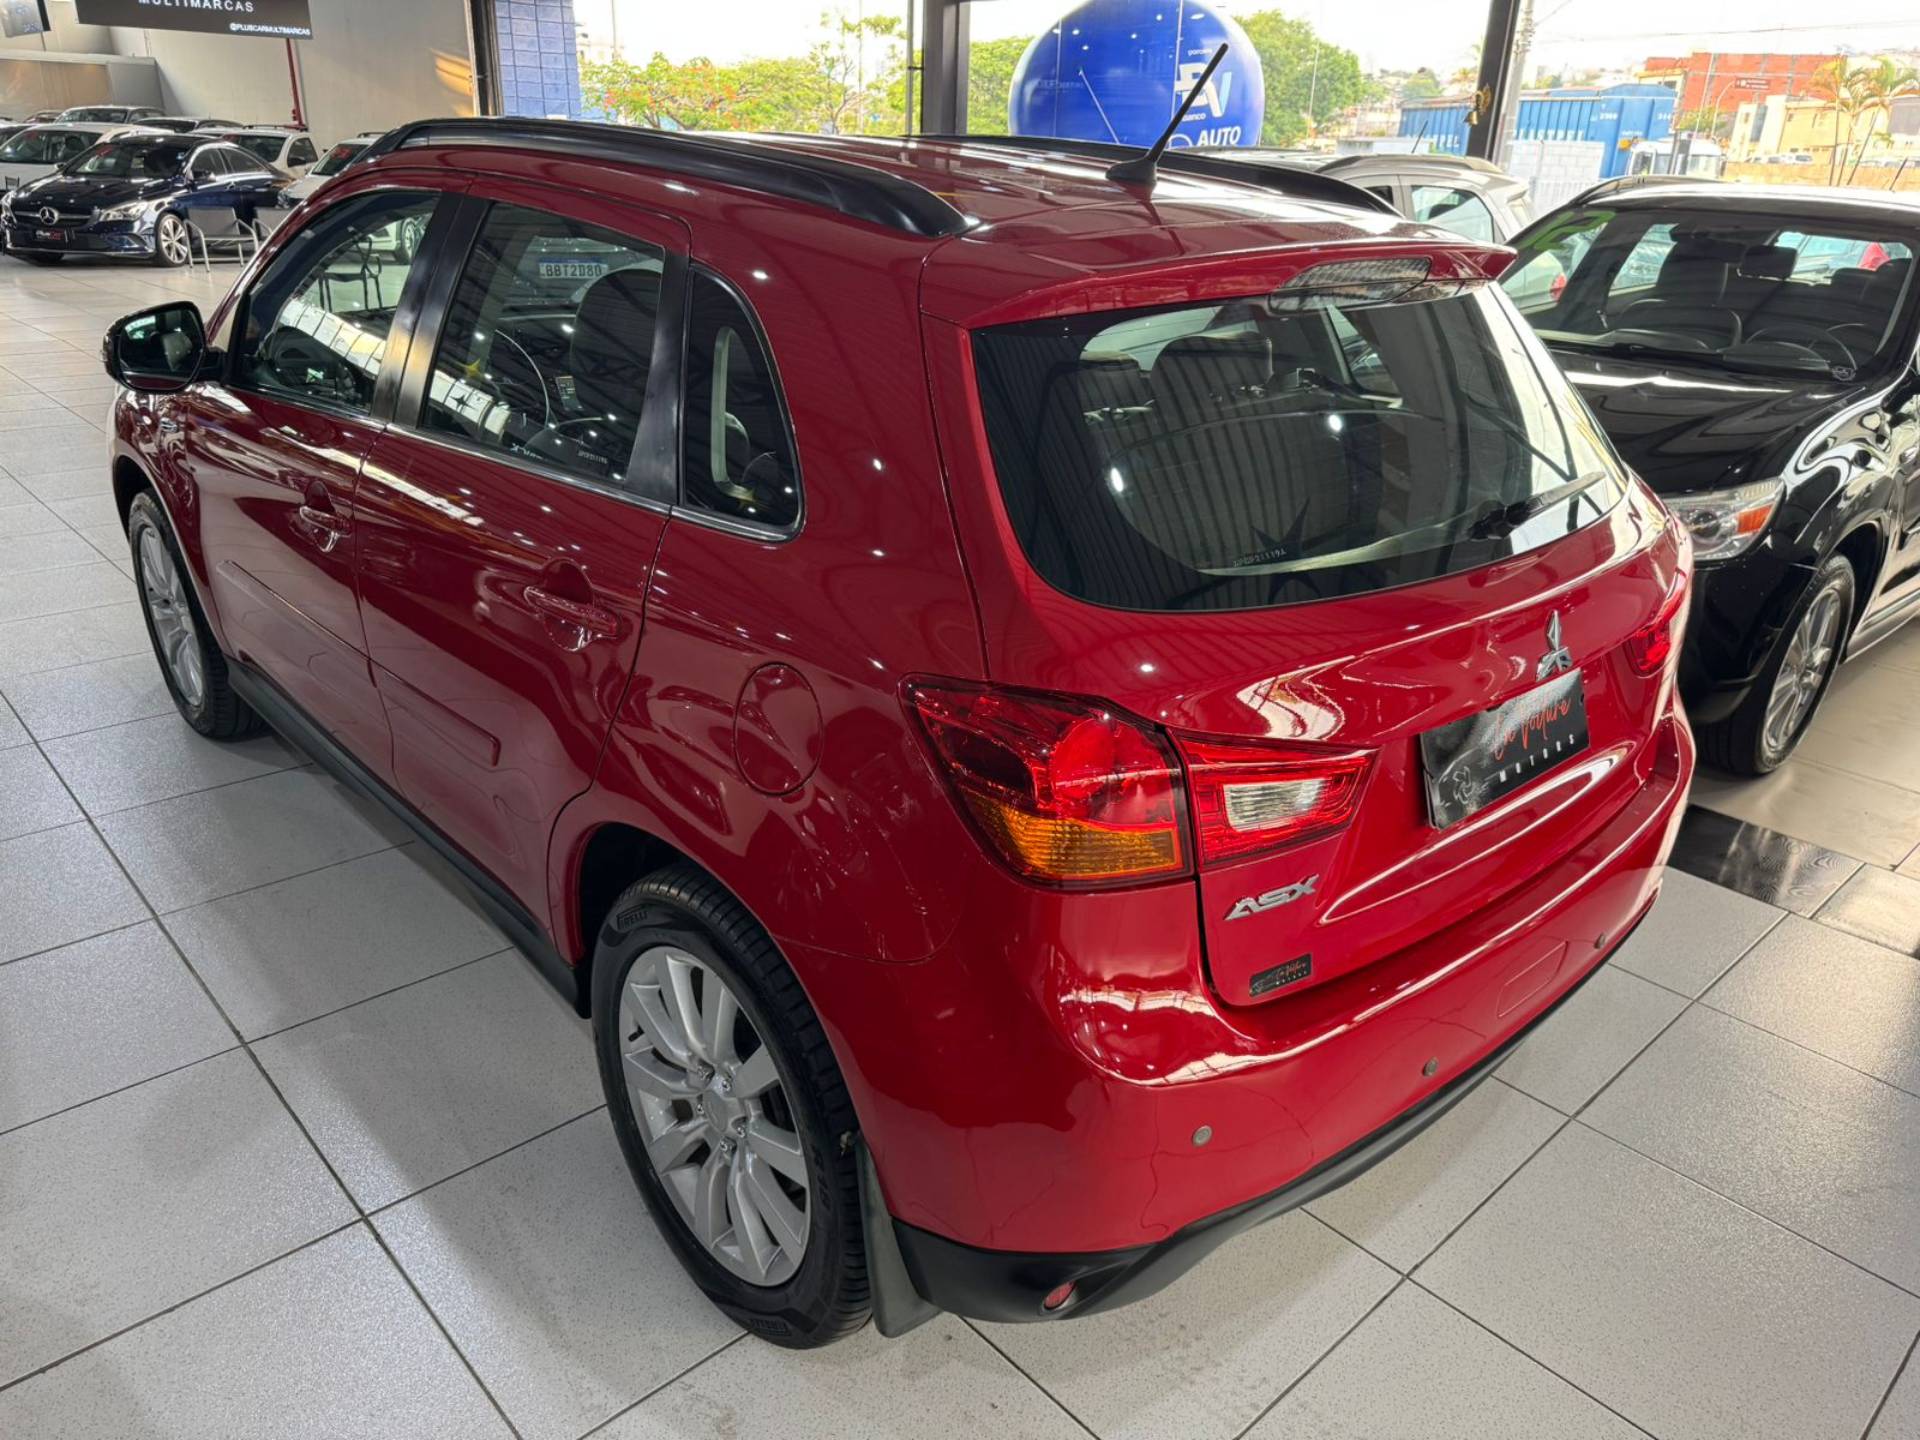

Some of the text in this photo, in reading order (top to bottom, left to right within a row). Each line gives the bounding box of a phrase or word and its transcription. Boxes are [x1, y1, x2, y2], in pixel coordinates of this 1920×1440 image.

[1197, 125, 1242, 147] AUTO
[1499, 733, 1575, 783] MOTORS
[1223, 873, 1320, 921] ASX
